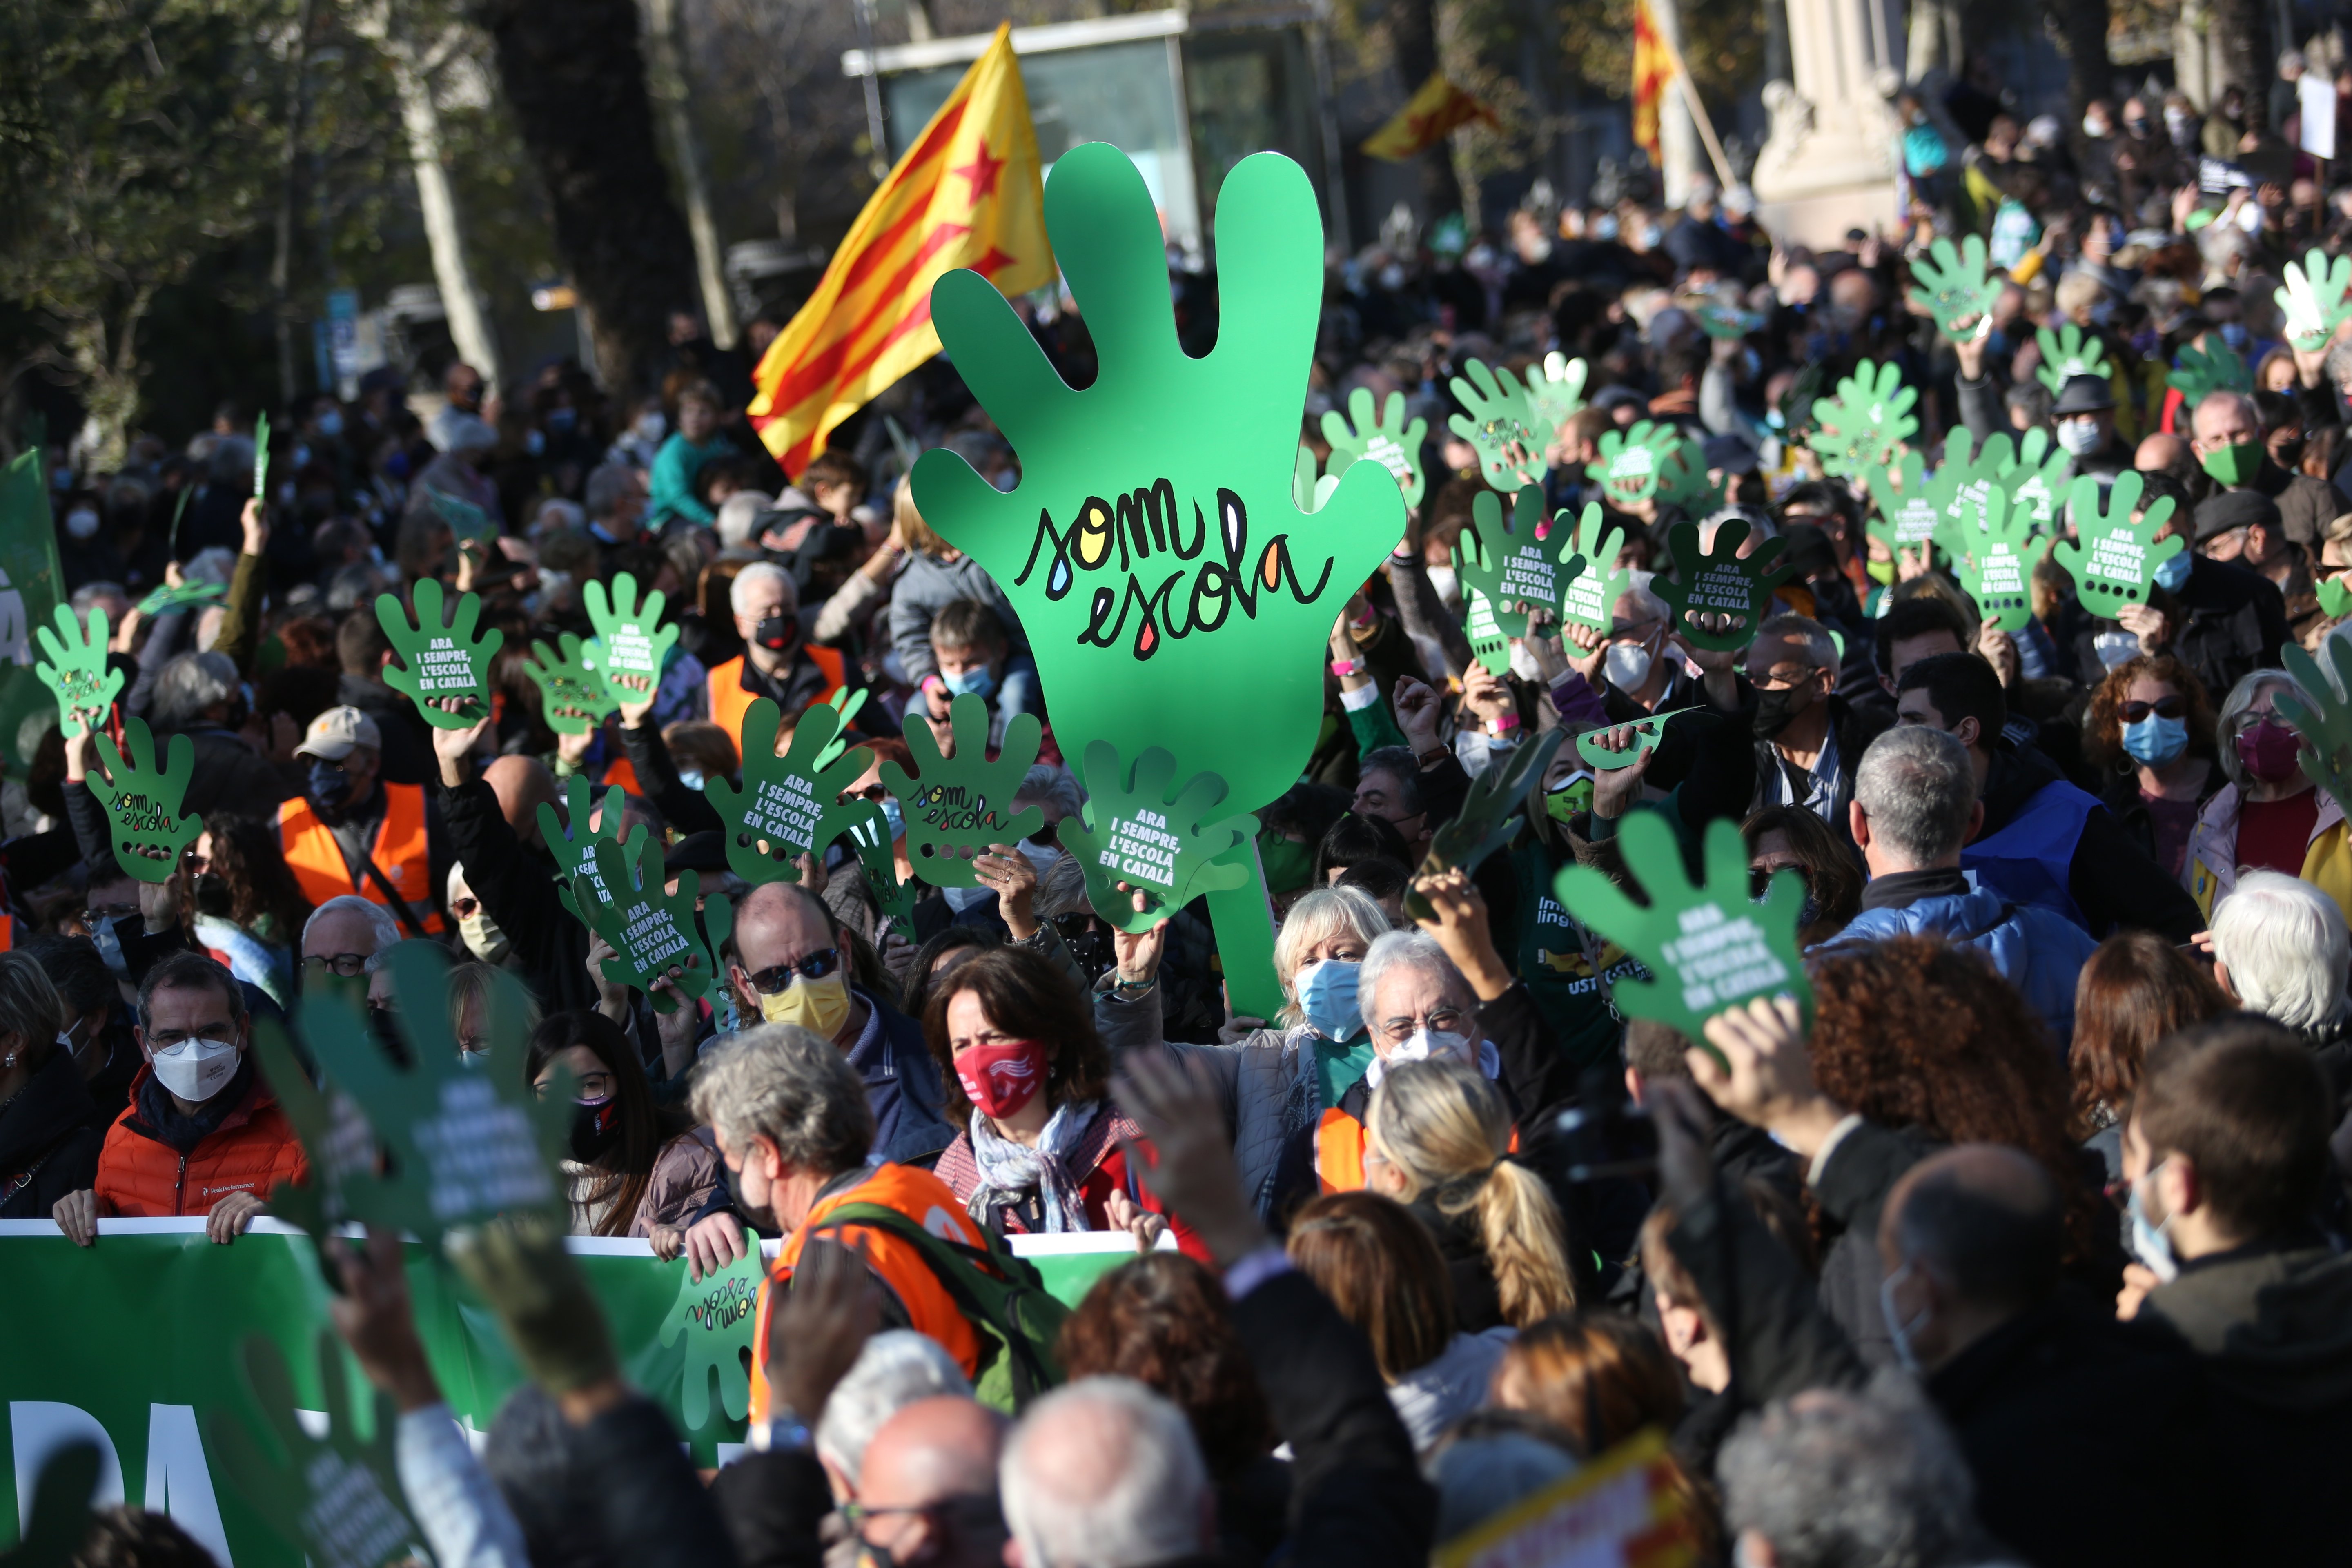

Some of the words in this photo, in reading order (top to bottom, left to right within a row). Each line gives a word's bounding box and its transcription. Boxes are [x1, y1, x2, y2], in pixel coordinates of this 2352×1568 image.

[1014, 478, 1206, 601] som
[2092, 537, 2099, 549] I
[2109, 527, 2134, 543] ARA
[1519, 545, 1542, 560] ARA
[1077, 488, 1334, 661] escola
[1503, 555, 1508, 567] I
[1511, 556, 1556, 579] SEMPRE,
[1506, 568, 1553, 589] L'ESCOLA
[1714, 563, 1740, 575] ARA
[2085, 561, 2102, 576] EN
[2103, 564, 2143, 585] CATALÀ
[1694, 571, 1700, 580] I
[1702, 572, 1754, 589] SEMPRE,
[1695, 582, 1748, 597] L'ESCOLA
[1500, 581, 1516, 595] EN
[1519, 584, 1556, 603] CATALÀ
[1687, 593, 1704, 604] EN
[1707, 596, 1750, 610] CATALÀ
[430, 637, 454, 650] ARA
[416, 652, 421, 664] I
[423, 649, 472, 664] SEMPRE,
[419, 678, 435, 690] EN
[437, 672, 477, 689] CATALÀ
[421, 663, 471, 677] L'ESCOLA
[783, 774, 813, 796] ARA
[907, 783, 973, 810] som
[108, 791, 153, 814] som
[758, 780, 766, 793] I
[767, 785, 824, 821] SEMPRE,
[121, 801, 180, 833] escola
[755, 797, 815, 833] L'ESCOLA
[922, 794, 1009, 831] escola
[1135, 809, 1165, 830] ARA
[743, 811, 764, 829] EN
[766, 820, 813, 850] CATALÀ
[1111, 817, 1118, 831] I
[1120, 821, 1181, 854] SEMPRE,
[583, 845, 595, 860] AR
[1109, 835, 1173, 868] L'ESCOLA
[1099, 851, 1120, 869] EN
[1123, 859, 1174, 886] CATALÀ
[628, 901, 651, 922] ARA
[619, 932, 627, 944] I
[626, 909, 673, 940] SEMPRE,
[629, 923, 677, 957] L'ESCOLA
[634, 957, 649, 973] EN
[648, 933, 689, 964] CATALÀ
[685, 1276, 749, 1331] escola
